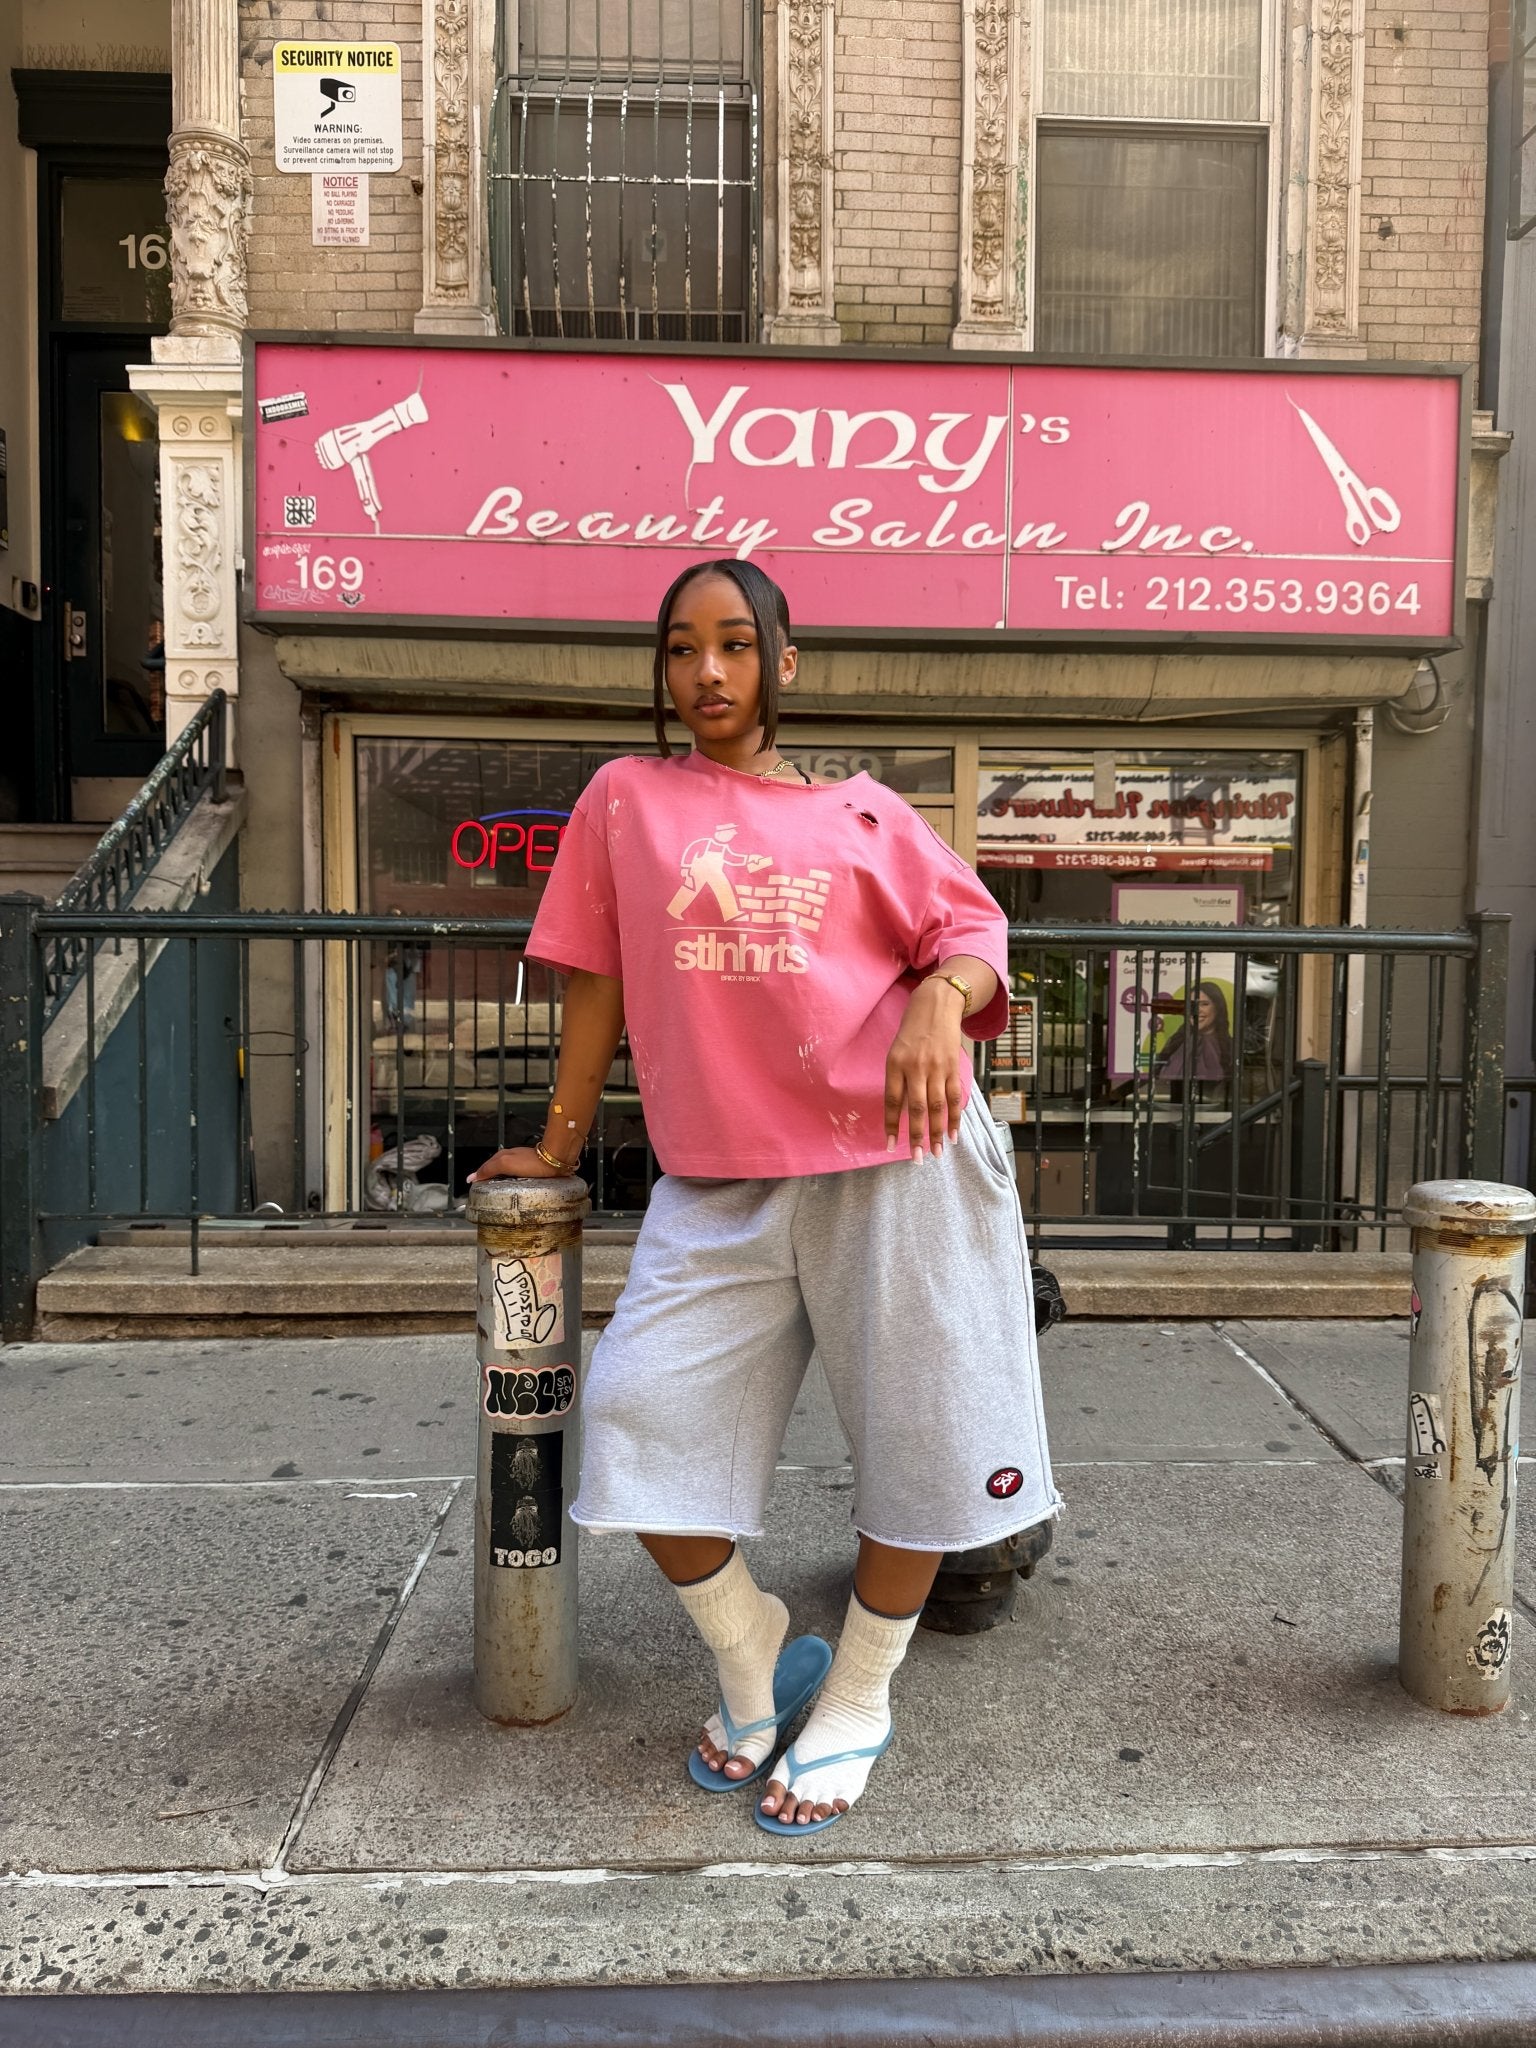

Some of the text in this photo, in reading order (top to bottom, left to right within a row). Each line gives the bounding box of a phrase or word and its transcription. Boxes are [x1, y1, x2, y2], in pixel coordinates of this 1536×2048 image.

[281, 50, 393, 67] SECURITY NOTICE
[314, 124, 363, 134] WARNING:
[292, 136, 312, 144] Video
[353, 138, 384, 146] premises.
[283, 146, 324, 154] Surveillance
[380, 147, 394, 155] stop
[292, 157, 318, 165] prevent
[322, 176, 359, 187] NOTICE
[119, 233, 174, 270] 16
[662, 383, 1071, 494] Yany's
[465, 486, 1254, 560] Beauty Salon Inc.
[294, 555, 364, 591] 169
[1055, 576, 1422, 616] Tel: 212.353.9364
[990, 1057, 1014, 1067] HANK
[494, 1546, 558, 1568] TOGO
